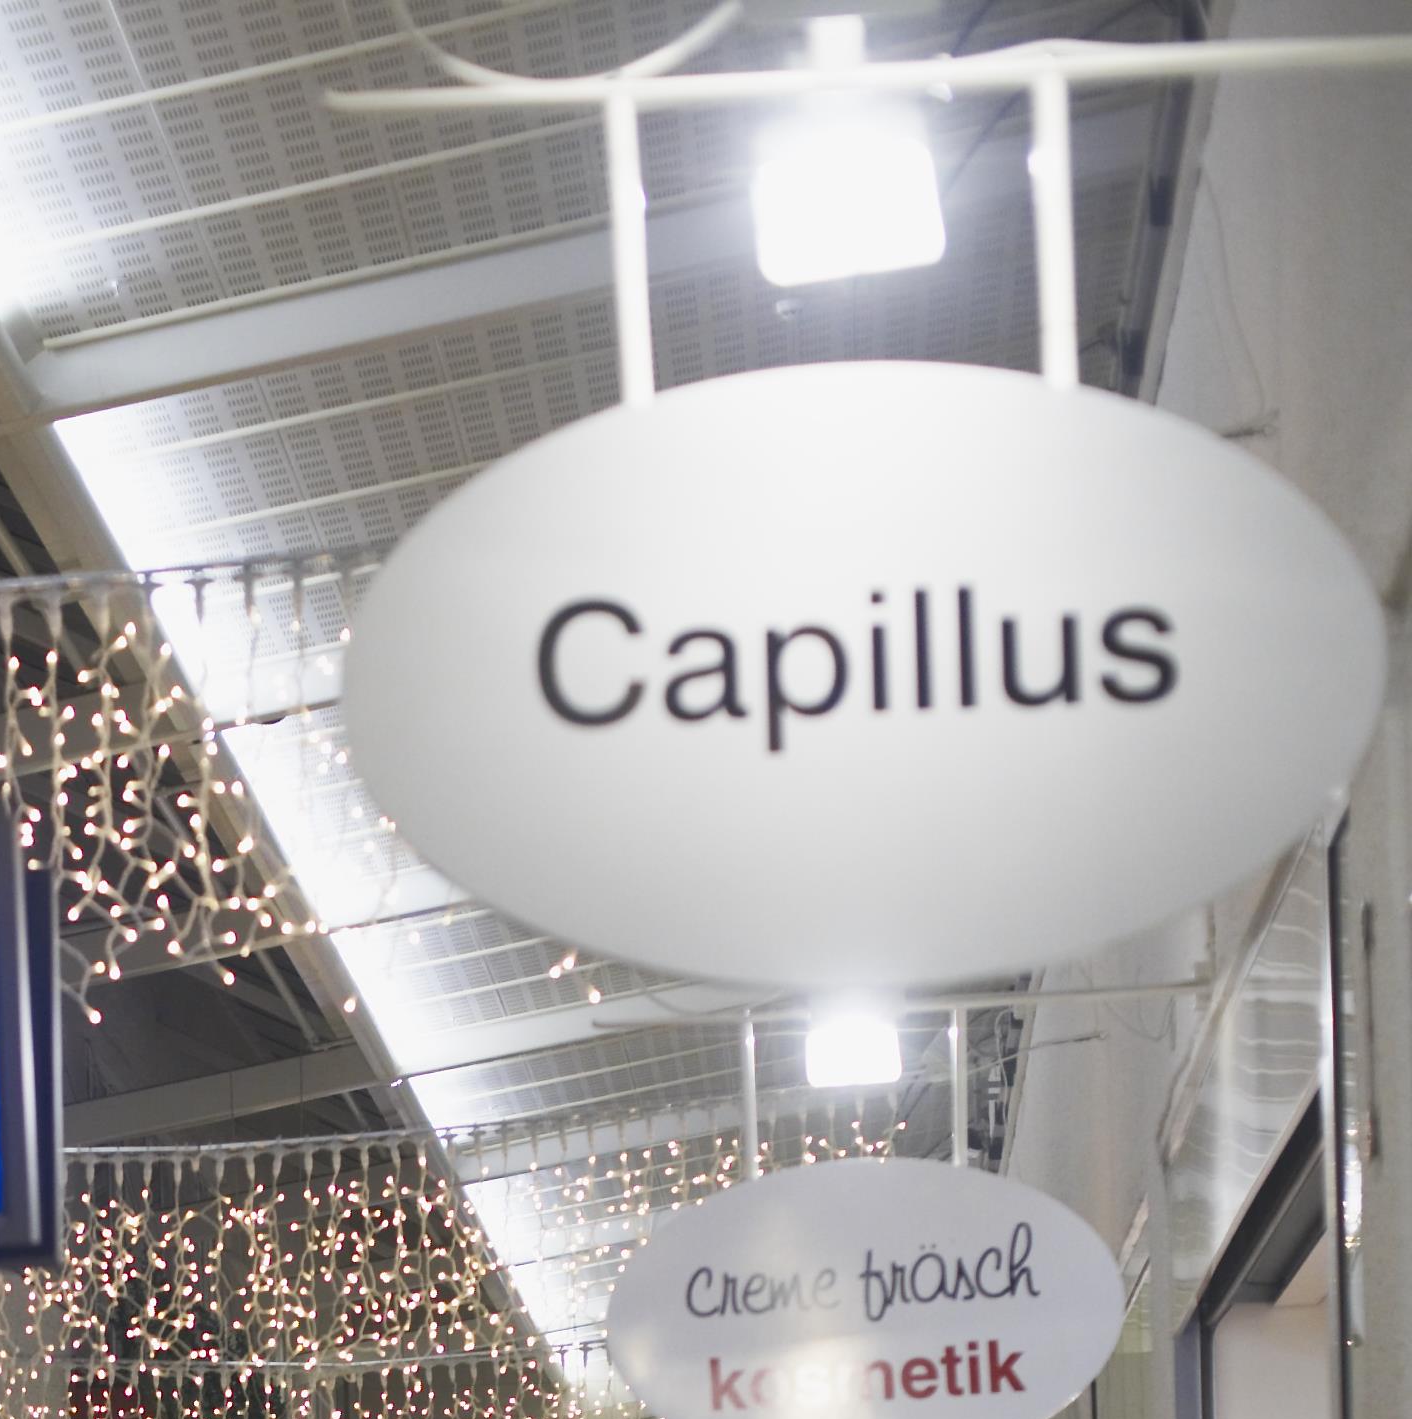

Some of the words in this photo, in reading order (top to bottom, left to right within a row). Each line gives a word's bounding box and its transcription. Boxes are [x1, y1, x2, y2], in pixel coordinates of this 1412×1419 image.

[536, 584, 1180, 754] Capillus
[685, 1266, 841, 1318] creme
[859, 1221, 1041, 1323] fräsch
